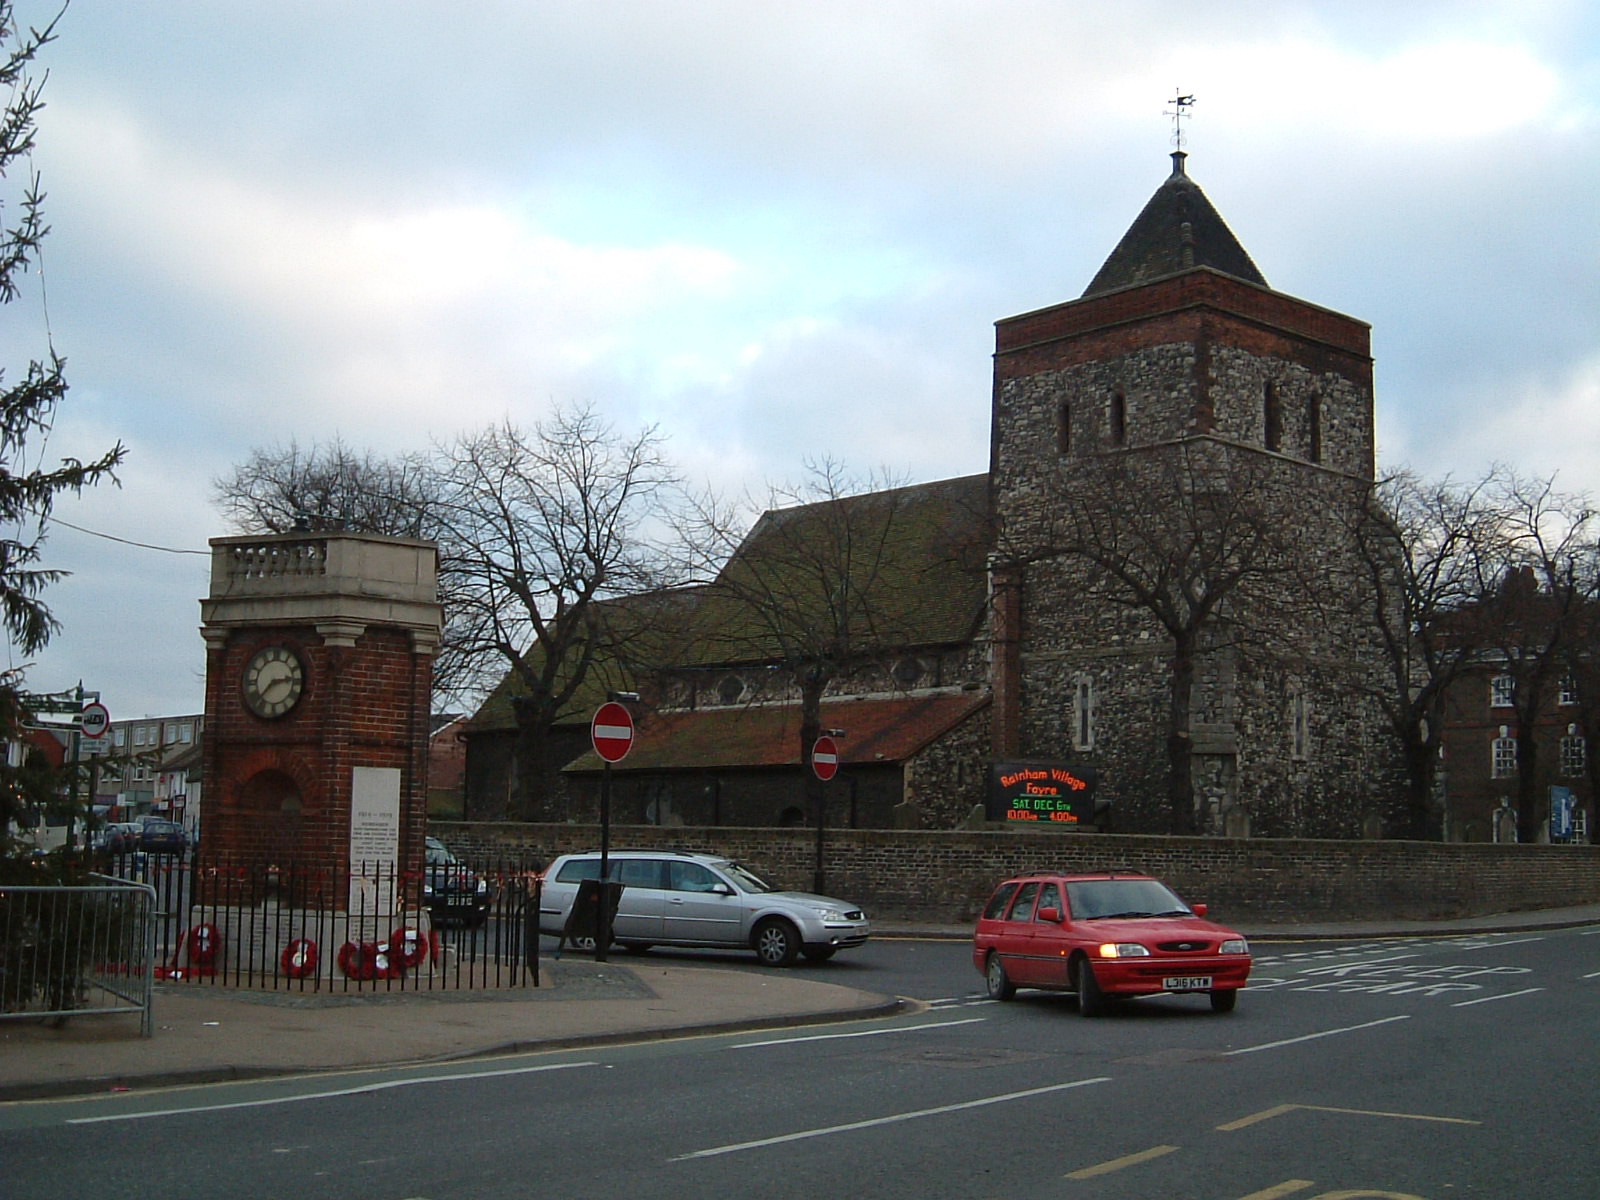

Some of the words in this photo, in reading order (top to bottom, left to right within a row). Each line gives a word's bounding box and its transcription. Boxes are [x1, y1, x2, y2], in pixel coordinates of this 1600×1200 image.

[1000, 768, 1048, 788] Rainham
[1051, 768, 1087, 791] Village
[1026, 782, 1057, 797] Fayre
[1306, 963, 1533, 979] KEEP
